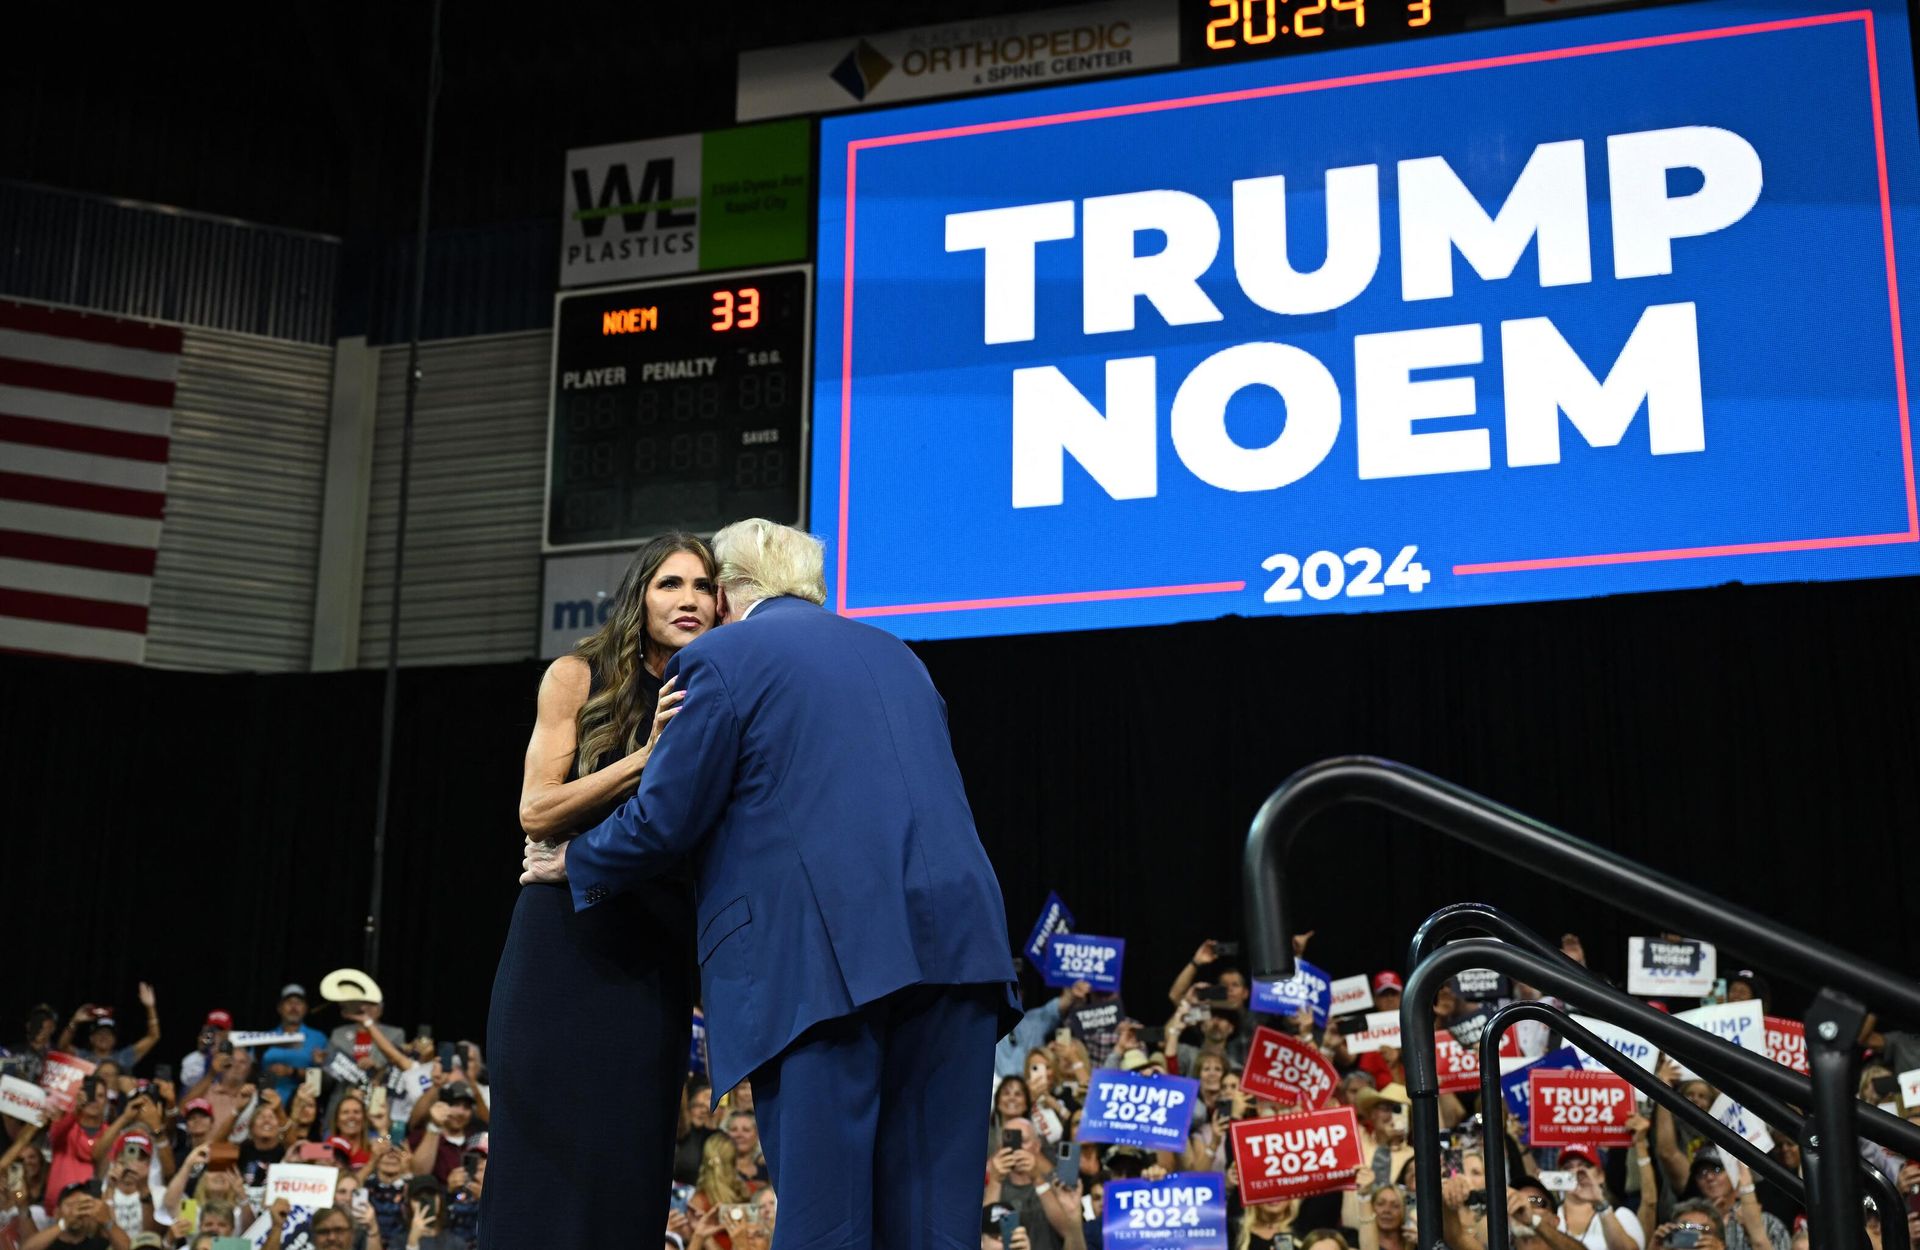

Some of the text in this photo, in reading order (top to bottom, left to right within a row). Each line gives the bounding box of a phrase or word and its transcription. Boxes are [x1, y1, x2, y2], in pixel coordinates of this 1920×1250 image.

[901, 21, 1132, 77] ORTHOPEDIC
[972, 49, 1133, 85] & SPINE CENTER
[571, 157, 697, 238] WL
[945, 126, 1762, 345] TRUMP
[568, 231, 694, 266] PLASTICS
[602, 306, 658, 336] NOEM
[712, 287, 760, 332] 33
[563, 366, 627, 390] PLAYER
[642, 357, 717, 382] PENALTY
[1012, 302, 1705, 509] NOEM
[742, 429, 779, 445] SAVES
[1261, 545, 1430, 602] 2024
[1031, 903, 1060, 955] TRUMP
[1053, 942, 1117, 962] TRUMP
[1649, 943, 1695, 956] TRUMP
[1060, 957, 1105, 974] 2024
[1076, 1004, 1118, 1020] TRUMP
[1263, 1040, 1331, 1091] TRUMP
[1099, 1083, 1185, 1109] TRUMP
[1540, 1086, 1625, 1107] TRUMP
[1103, 1101, 1167, 1126] 2024
[1109, 1120, 1138, 1131] TRUMP
[1552, 1106, 1615, 1125] 2024
[1245, 1124, 1347, 1158] TRUMP
[1264, 1148, 1338, 1177] 2024
[273, 1180, 329, 1194] TRUMP
[1250, 1180, 1274, 1190] TEXT
[1277, 1175, 1310, 1186] TRUMP
[1311, 1172, 1325, 1182] TO
[1115, 1187, 1213, 1210] TRUMP
[1129, 1207, 1200, 1229] 2024
[1115, 1230, 1137, 1240] TEXT
[1140, 1229, 1172, 1239] TRUMP
[1173, 1229, 1187, 1239] TO
